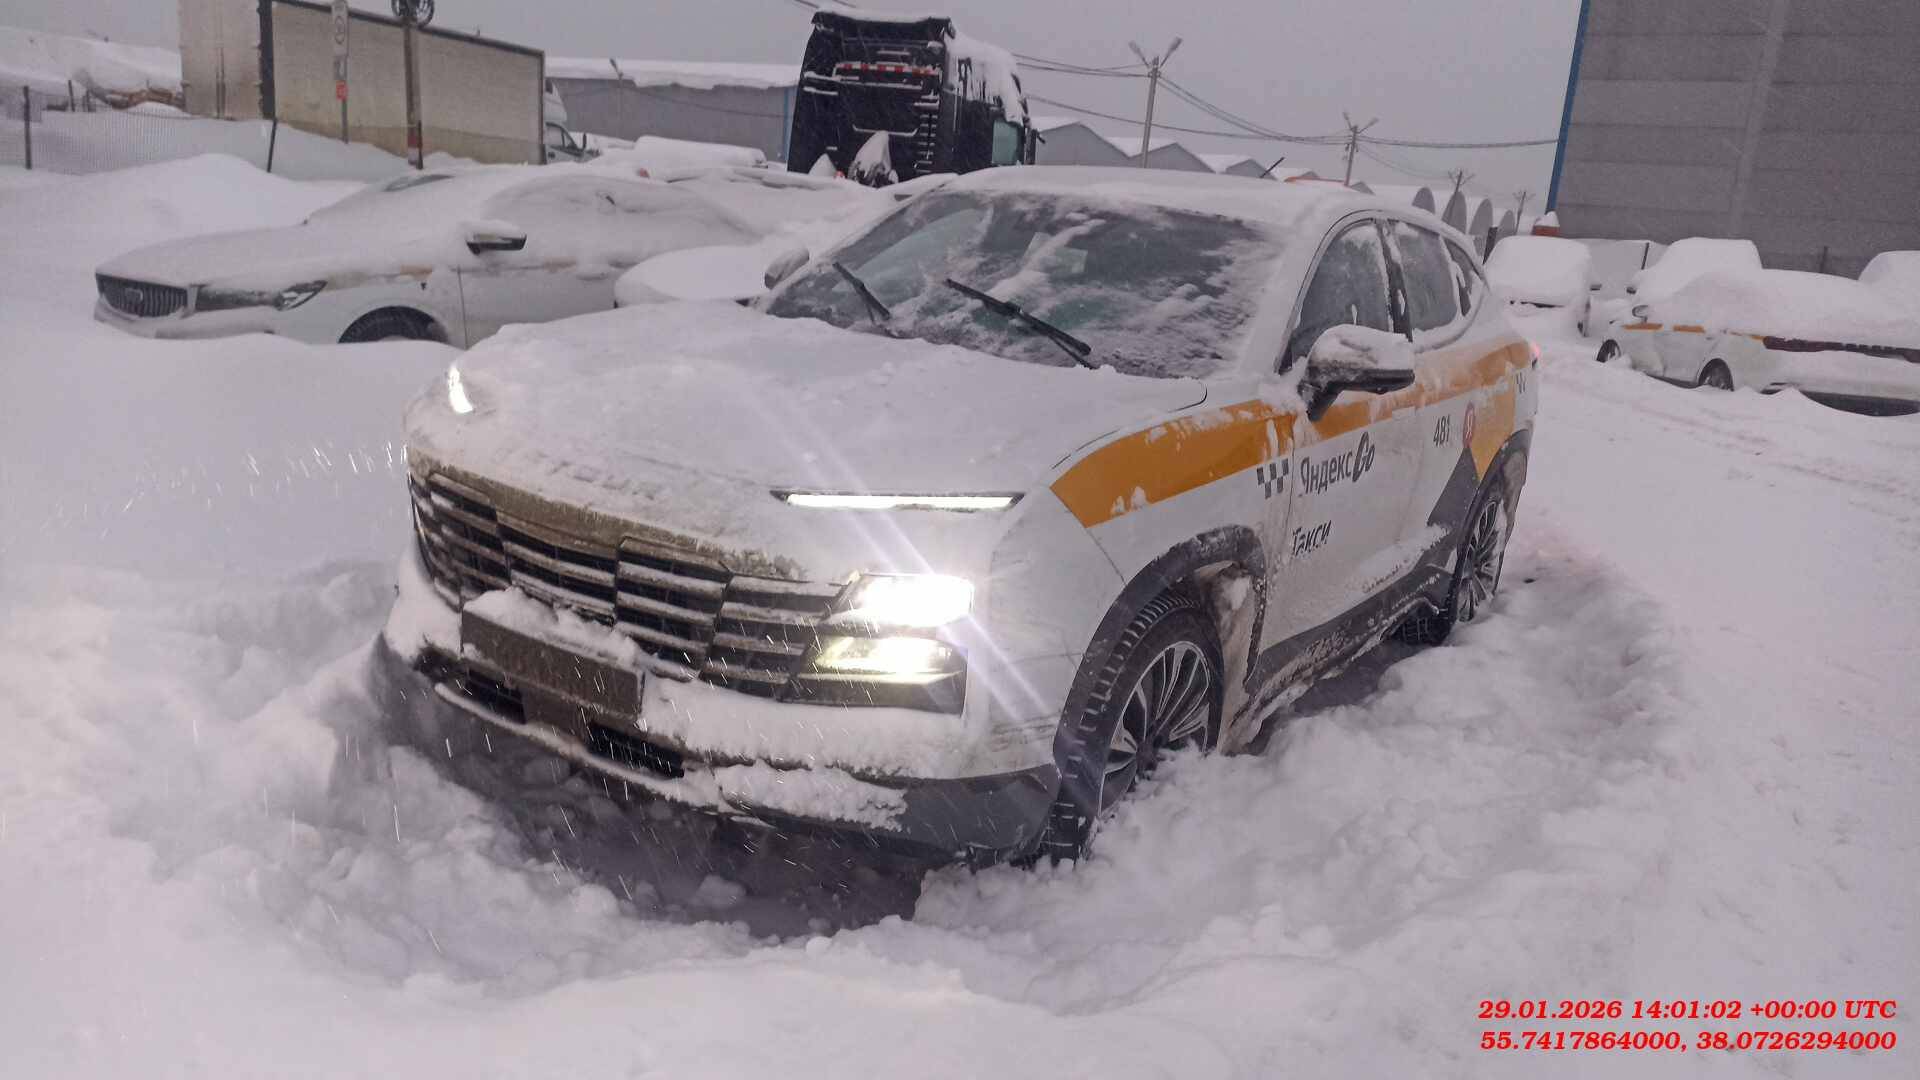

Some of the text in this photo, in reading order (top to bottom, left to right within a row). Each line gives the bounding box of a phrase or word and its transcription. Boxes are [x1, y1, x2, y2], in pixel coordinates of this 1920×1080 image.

[1433, 414, 1450, 447] 481
[1301, 431, 1376, 494] Яндекс Go
[1293, 519, 1332, 556] Такси
